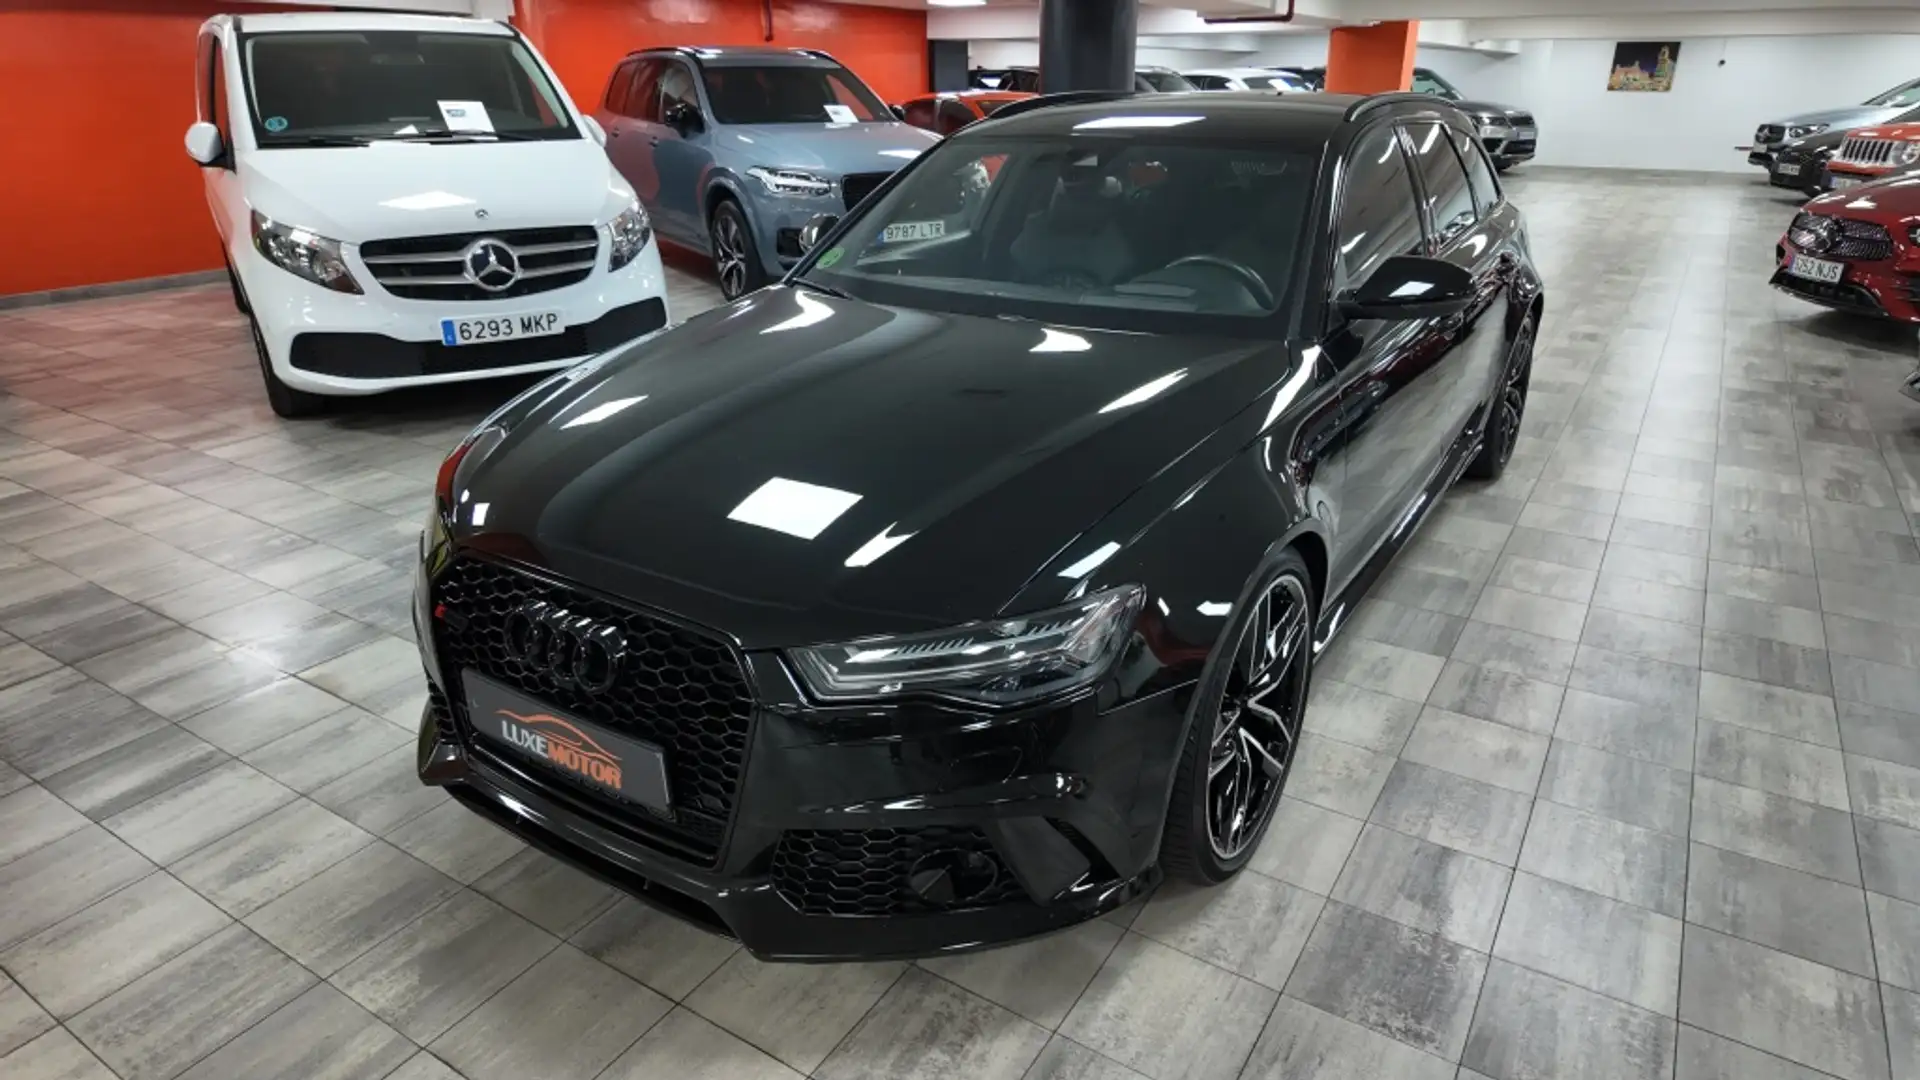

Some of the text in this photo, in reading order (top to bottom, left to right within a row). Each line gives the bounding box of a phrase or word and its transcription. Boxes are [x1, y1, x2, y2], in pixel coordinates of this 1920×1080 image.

[886, 225, 916, 239] 9787
[459, 319, 513, 340] 6293
[520, 313, 558, 334] MKP
[501, 719, 622, 789] LUXEMOTOR
